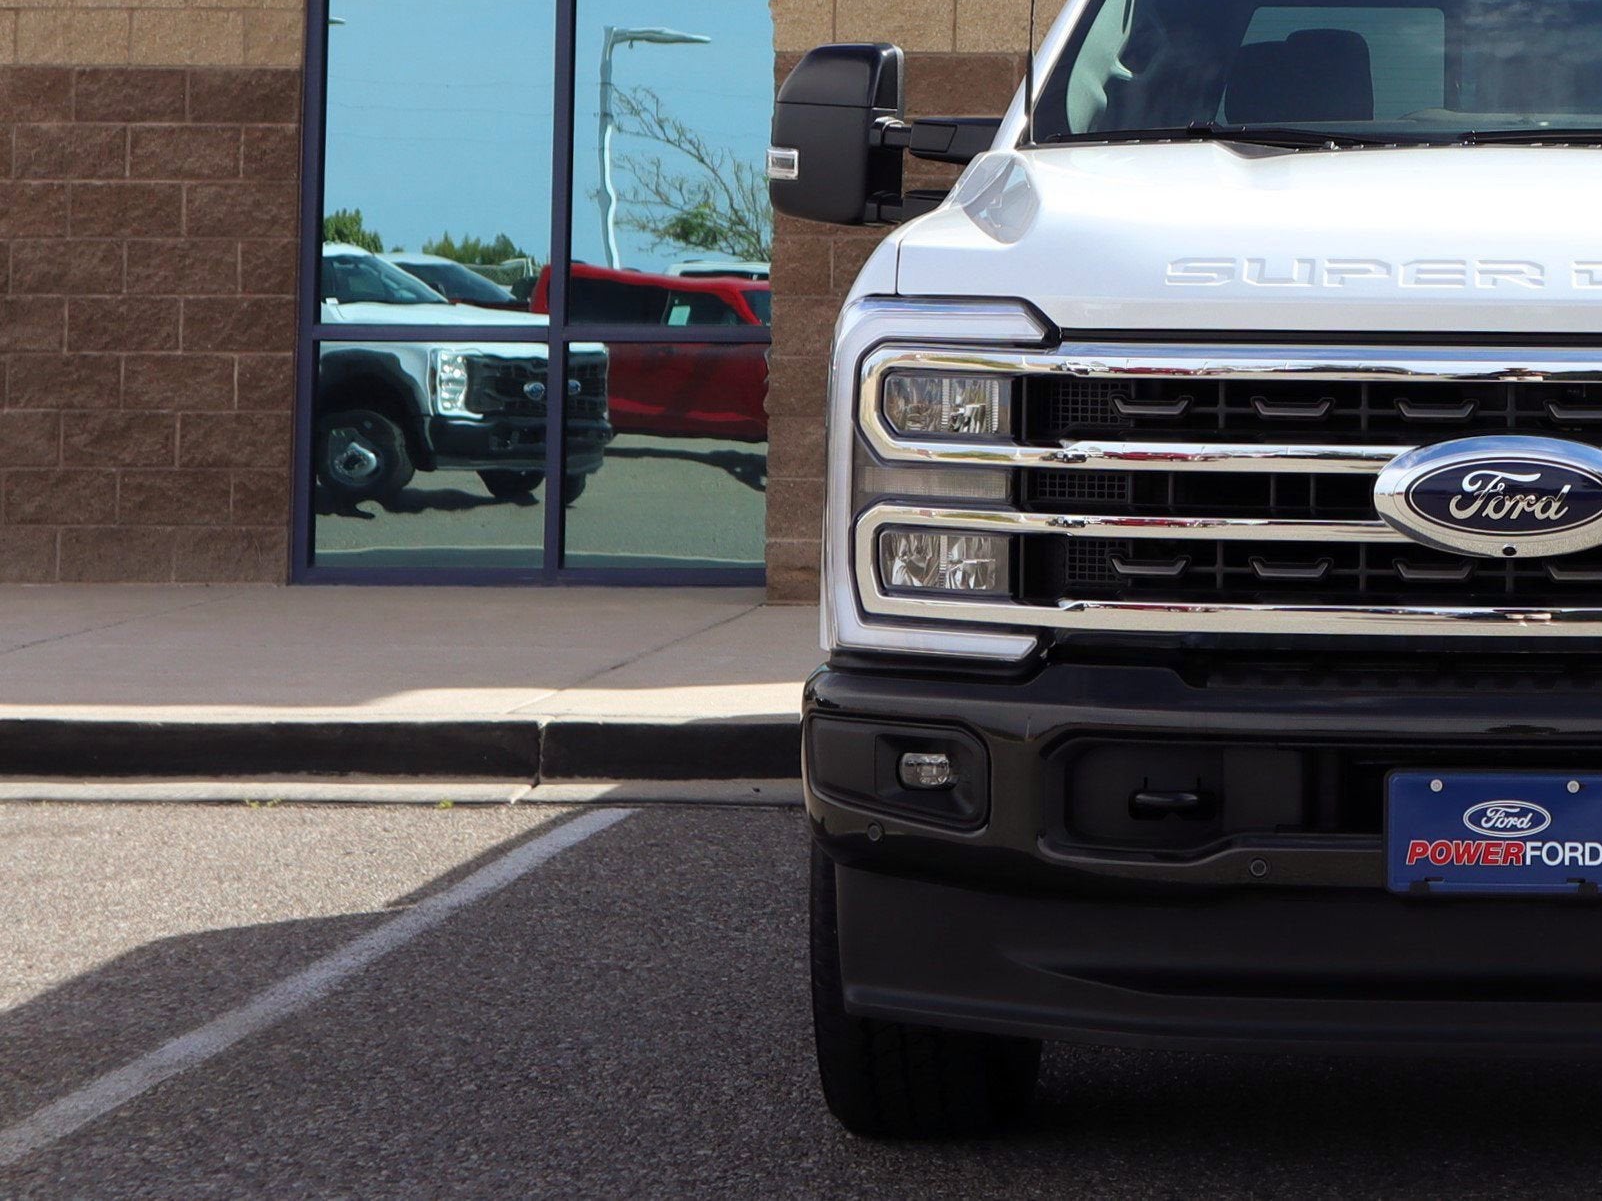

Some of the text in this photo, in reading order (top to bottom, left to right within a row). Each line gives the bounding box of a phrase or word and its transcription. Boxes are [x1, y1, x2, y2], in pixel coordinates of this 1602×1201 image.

[1165, 257, 1545, 289] SUPER
[1449, 470, 1572, 520] Ford
[1481, 807, 1532, 830] Ford
